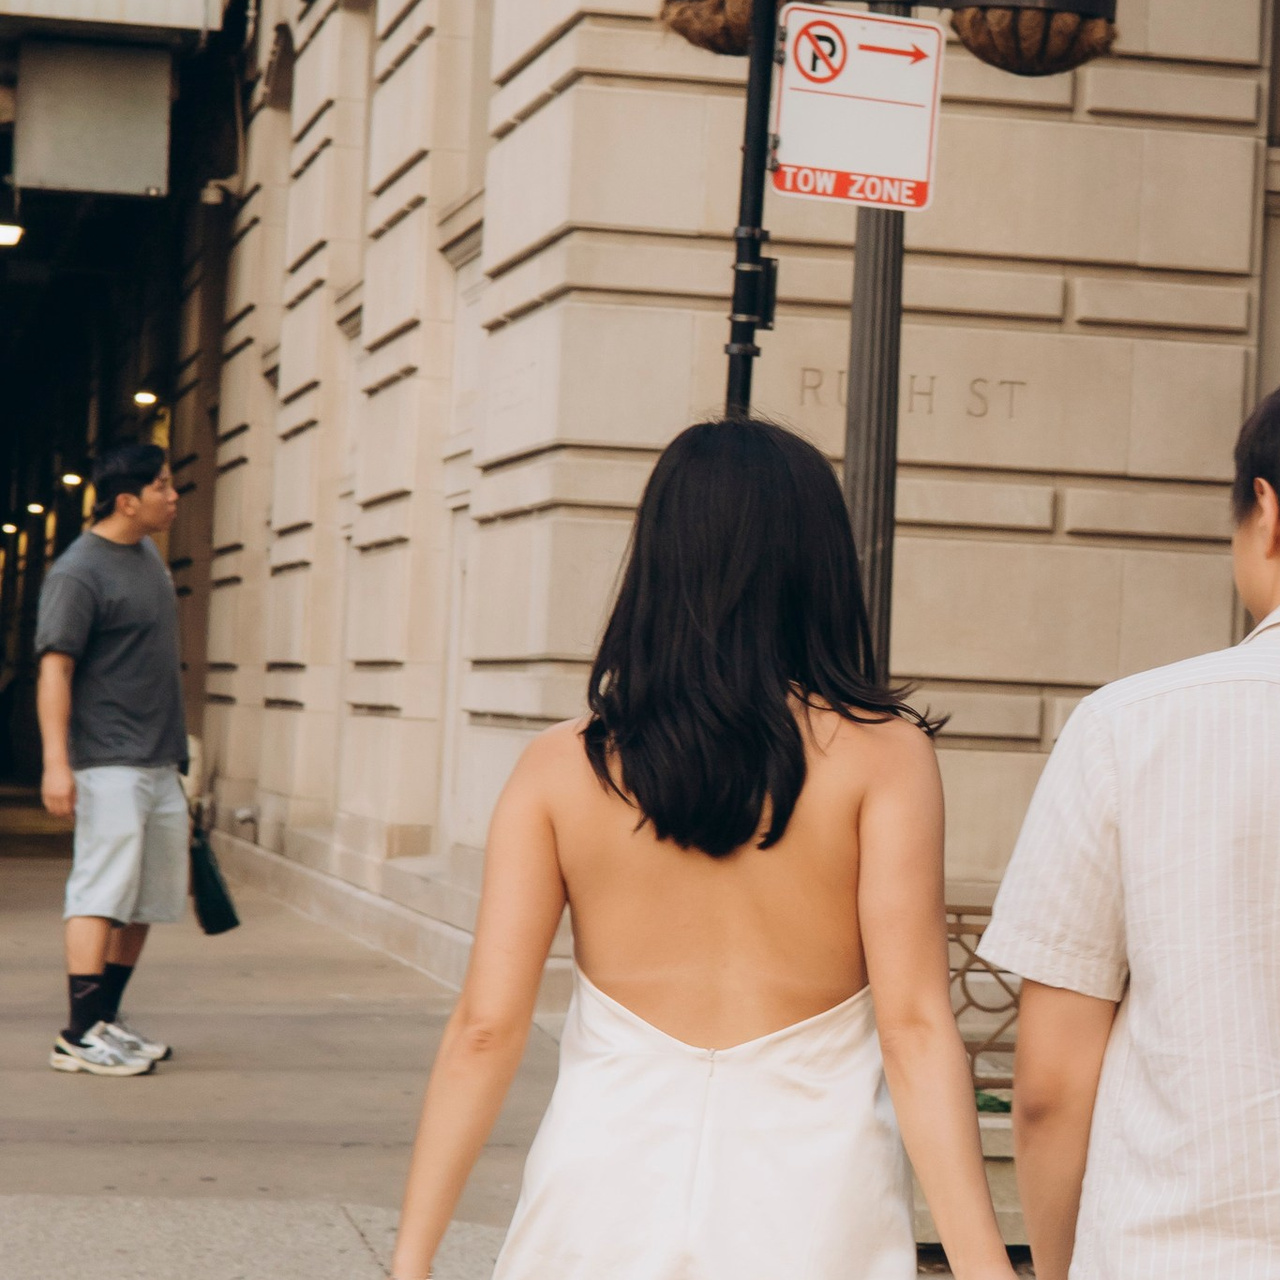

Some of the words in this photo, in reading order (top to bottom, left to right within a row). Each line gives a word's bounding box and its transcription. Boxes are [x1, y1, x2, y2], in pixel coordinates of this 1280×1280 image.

[811, 34, 837, 72] P
[782, 166, 837, 194] TOW
[847, 174, 917, 205] ZONE
[800, 367, 938, 414] RH
[966, 378, 1027, 419] ST
